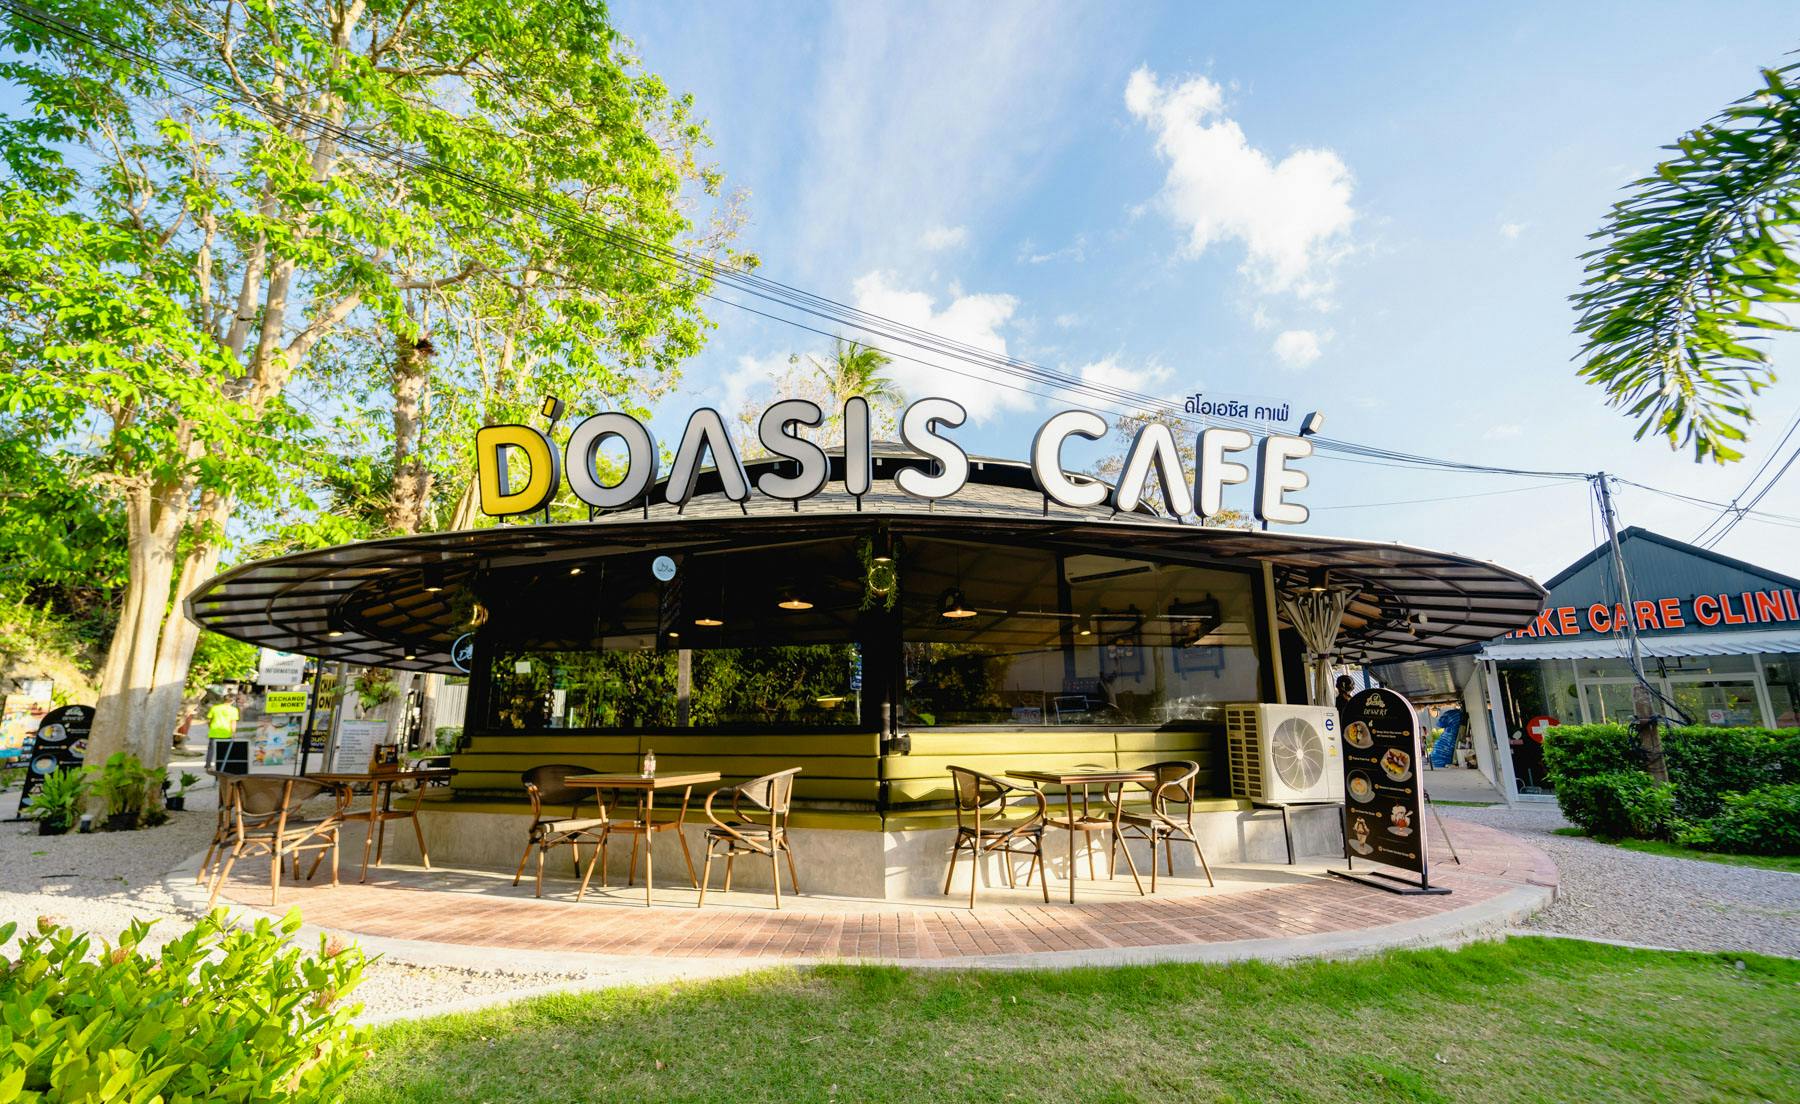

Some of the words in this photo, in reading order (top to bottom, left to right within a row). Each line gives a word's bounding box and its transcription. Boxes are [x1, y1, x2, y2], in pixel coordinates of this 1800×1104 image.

[1185, 394, 1248, 418] ดิโอเอซิส
[476, 395, 969, 516] D'OASIS
[1030, 409, 1326, 524] CAFÉ
[1505, 607, 1580, 639] AKE
[1588, 597, 1685, 633] CARE
[1693, 588, 1800, 627] CLINI
